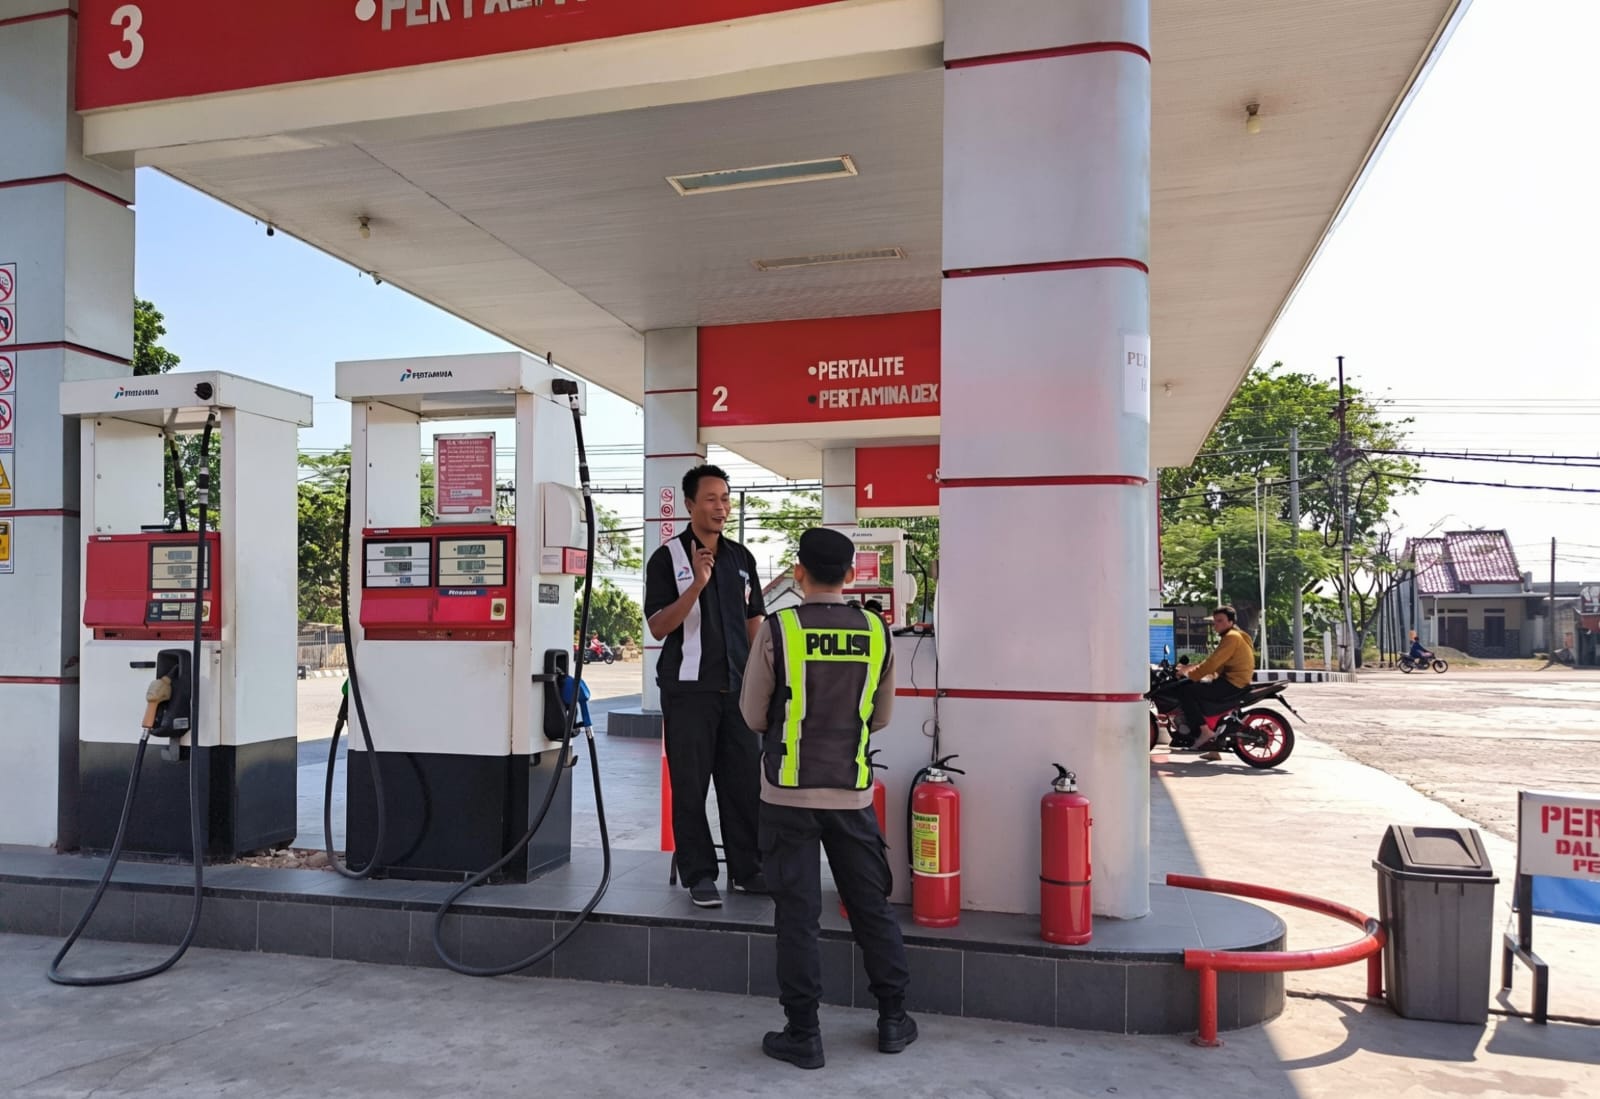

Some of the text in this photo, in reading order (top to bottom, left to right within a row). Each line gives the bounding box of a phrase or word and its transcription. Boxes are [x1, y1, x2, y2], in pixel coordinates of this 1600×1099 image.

[108, 4, 145, 70] 3
[818, 356, 905, 381] PERTALITE
[711, 386, 729, 412] 2
[863, 483, 873, 500] 1
